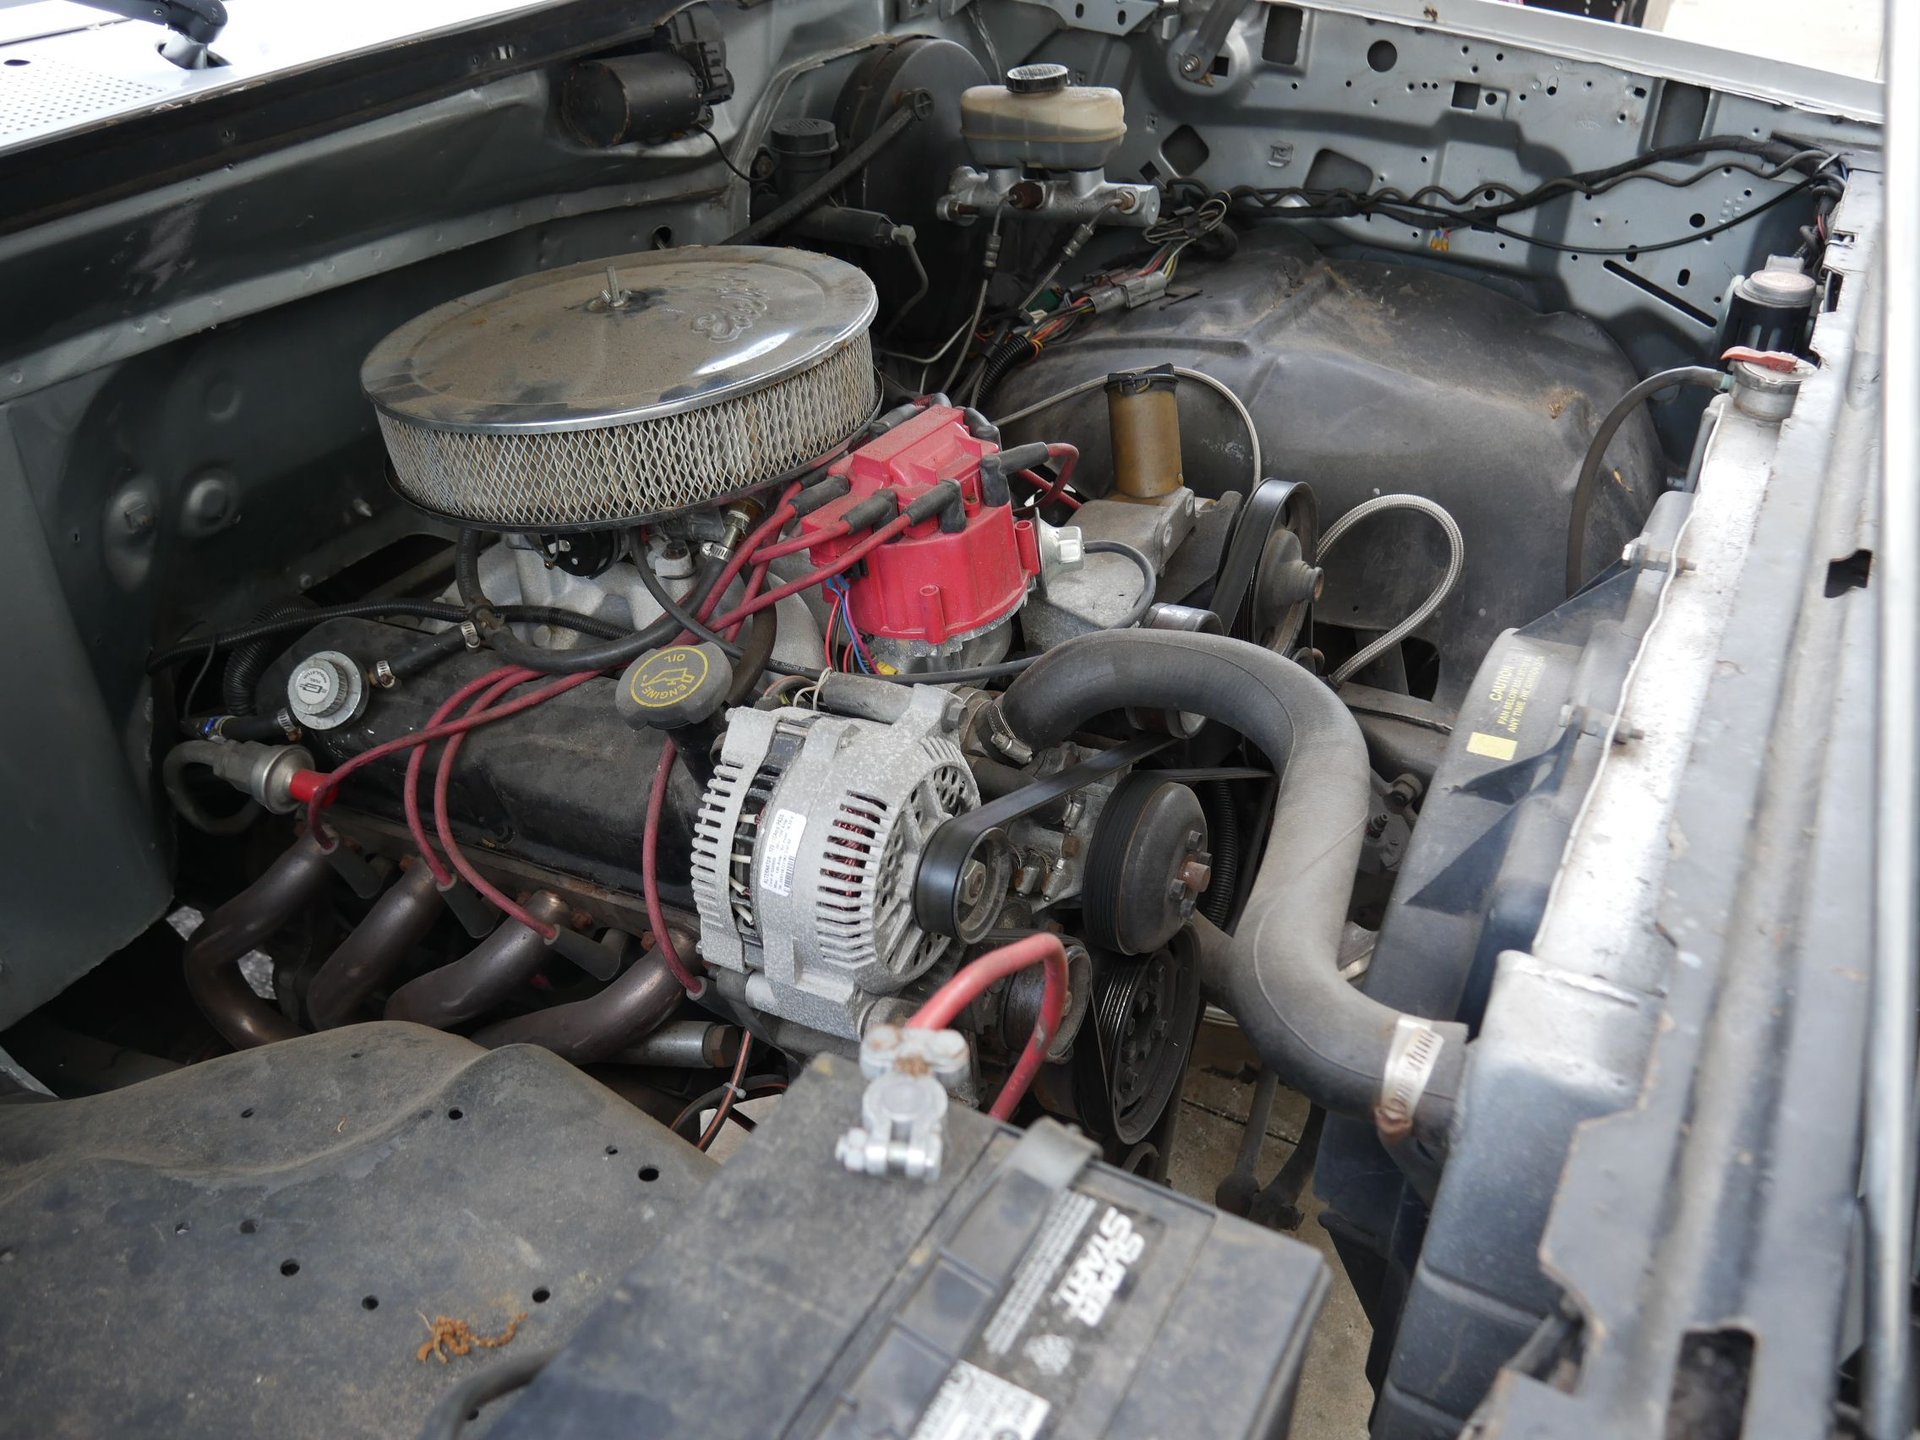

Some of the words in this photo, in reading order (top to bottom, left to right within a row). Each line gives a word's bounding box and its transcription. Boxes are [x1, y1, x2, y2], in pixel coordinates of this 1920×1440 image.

[664, 653, 686, 663] OIL
[641, 684, 688, 700] ENGINE
[1489, 665, 1514, 701] CAUTION
[1502, 686, 1519, 711] BELOW
[1512, 699, 1526, 717] TIME
[1497, 710, 1510, 725] FAN
[1506, 716, 1520, 733] ANY
[1060, 1206, 1132, 1304] START
[1078, 1232, 1145, 1327] SUPER
